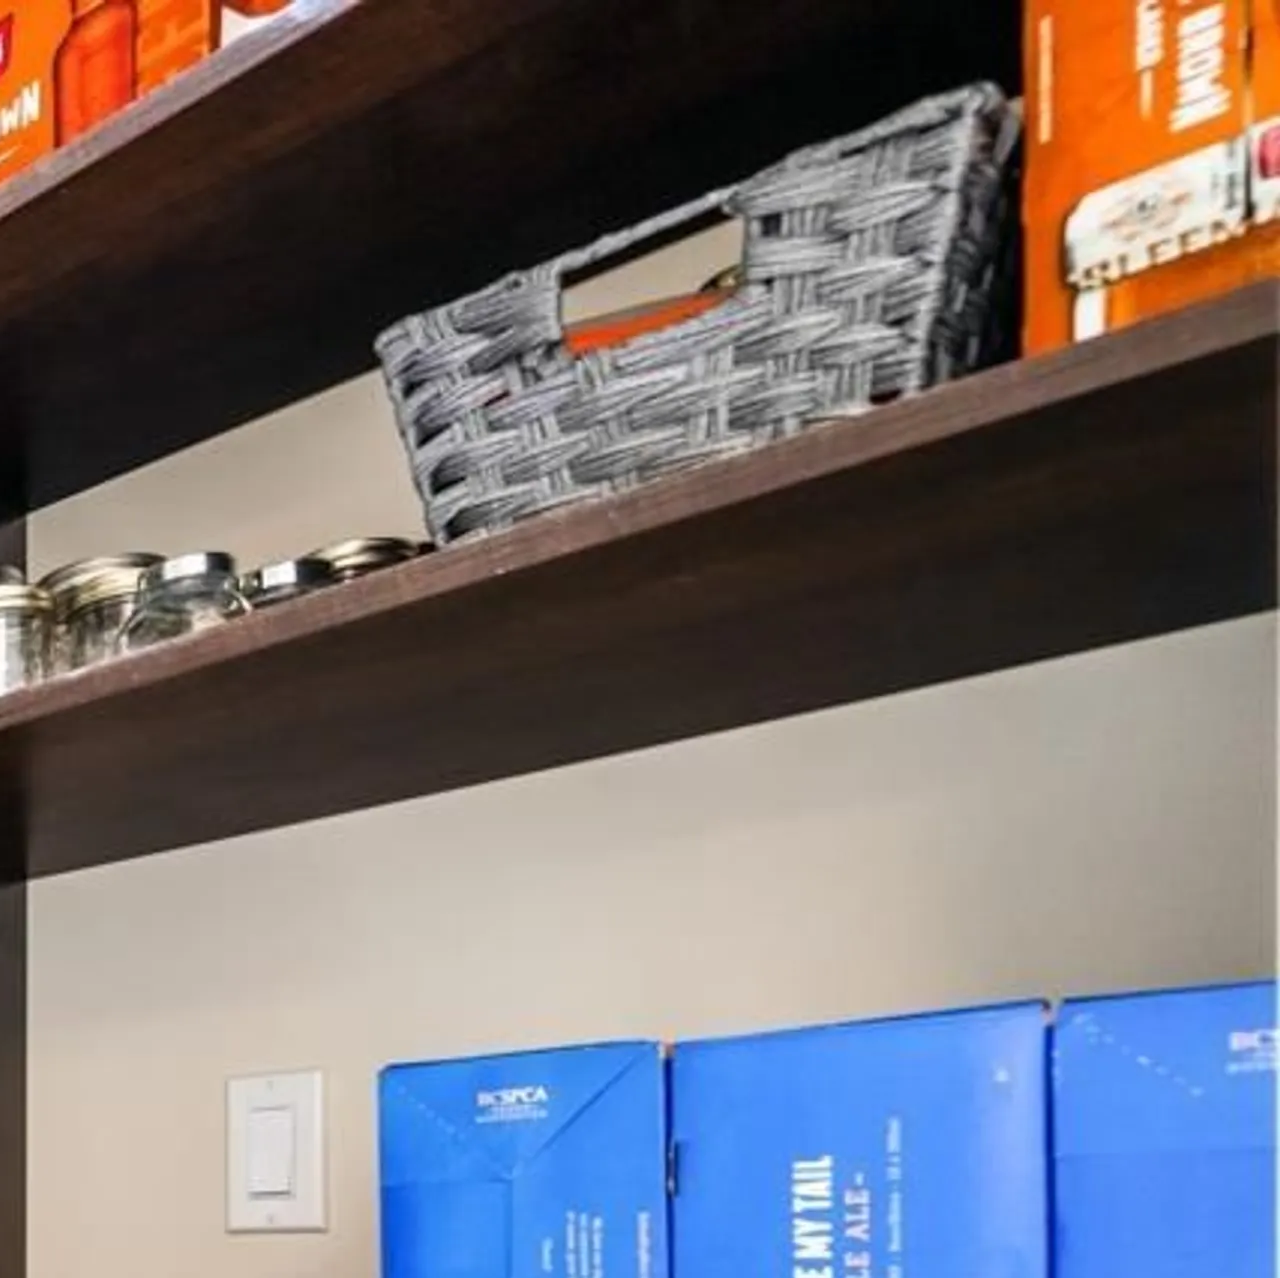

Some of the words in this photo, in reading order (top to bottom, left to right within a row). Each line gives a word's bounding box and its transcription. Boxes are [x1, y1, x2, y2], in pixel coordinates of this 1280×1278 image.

[791, 1154, 834, 1214] TAIL
[791, 1217, 834, 1260] MY
[844, 1188, 871, 1242] ALE
